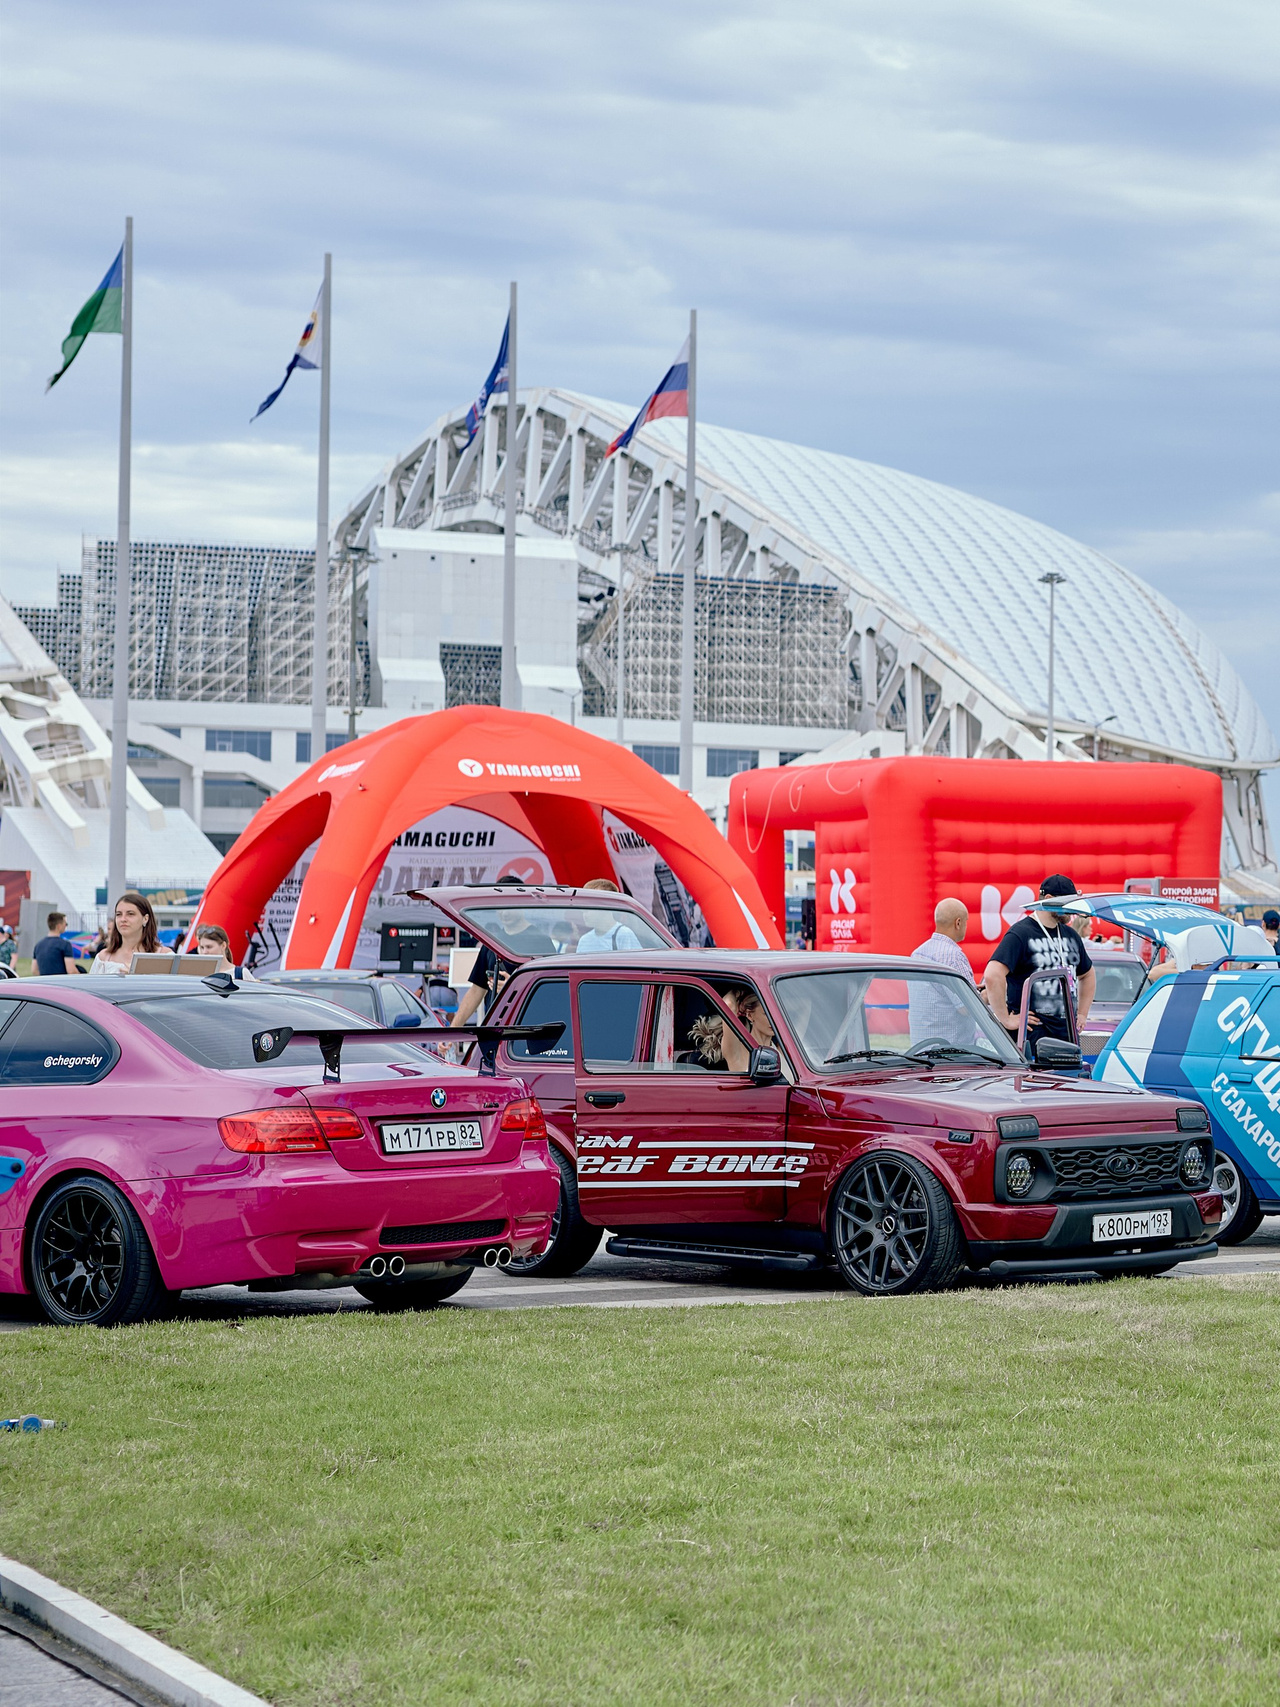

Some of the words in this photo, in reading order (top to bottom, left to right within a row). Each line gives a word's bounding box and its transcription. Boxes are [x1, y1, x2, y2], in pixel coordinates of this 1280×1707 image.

[486, 762, 581, 778] YAMAGUCHI
[1161, 886, 1192, 896] ОТКРОЙ
[1193, 887, 1217, 897] ЗАРЯД
[1165, 896, 1214, 904] СТРОЕНИЯ
[43, 1053, 103, 1069] @chegorsky
[459, 1124, 476, 1140] 82
[1150, 1212, 1169, 1227] 193
